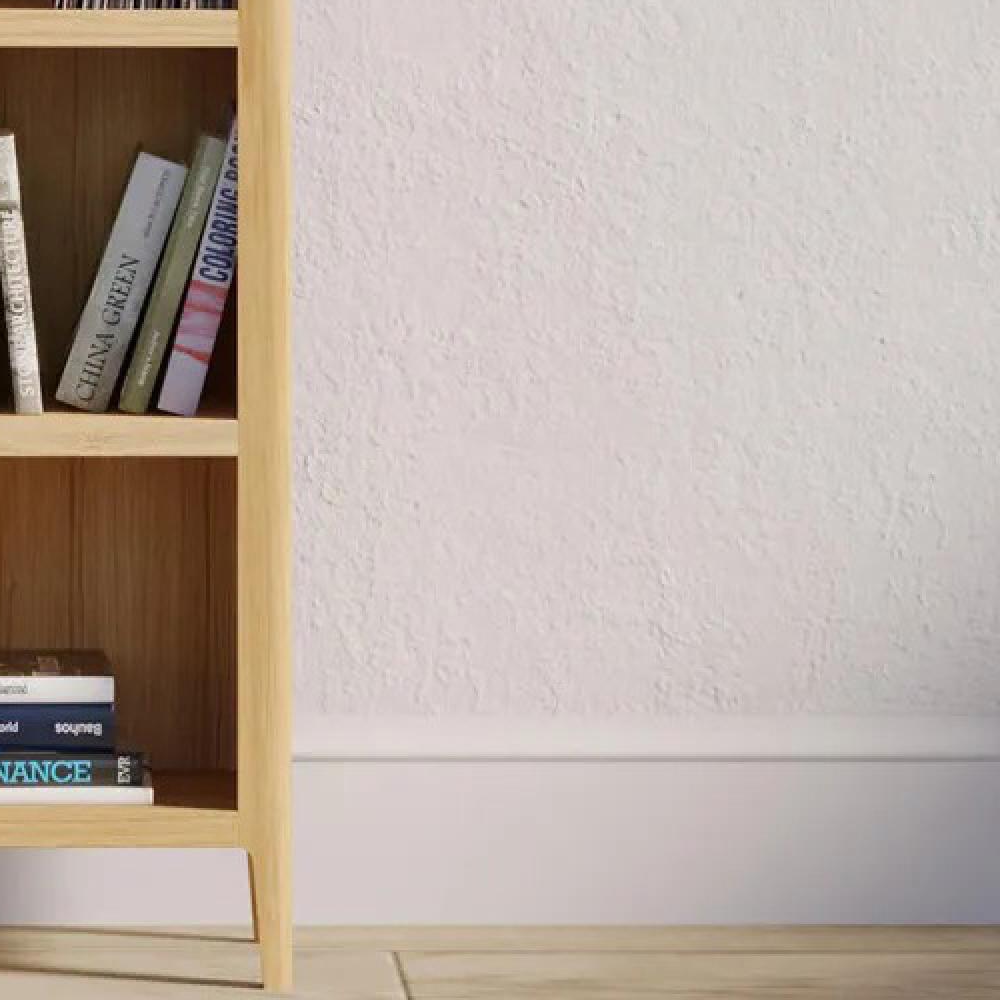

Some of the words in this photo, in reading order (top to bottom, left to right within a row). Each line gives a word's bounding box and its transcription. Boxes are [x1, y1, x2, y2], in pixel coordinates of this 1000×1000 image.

[200, 187, 238, 283] COLORING
[77, 333, 115, 402] CHINA
[102, 253, 140, 327] GREEN
